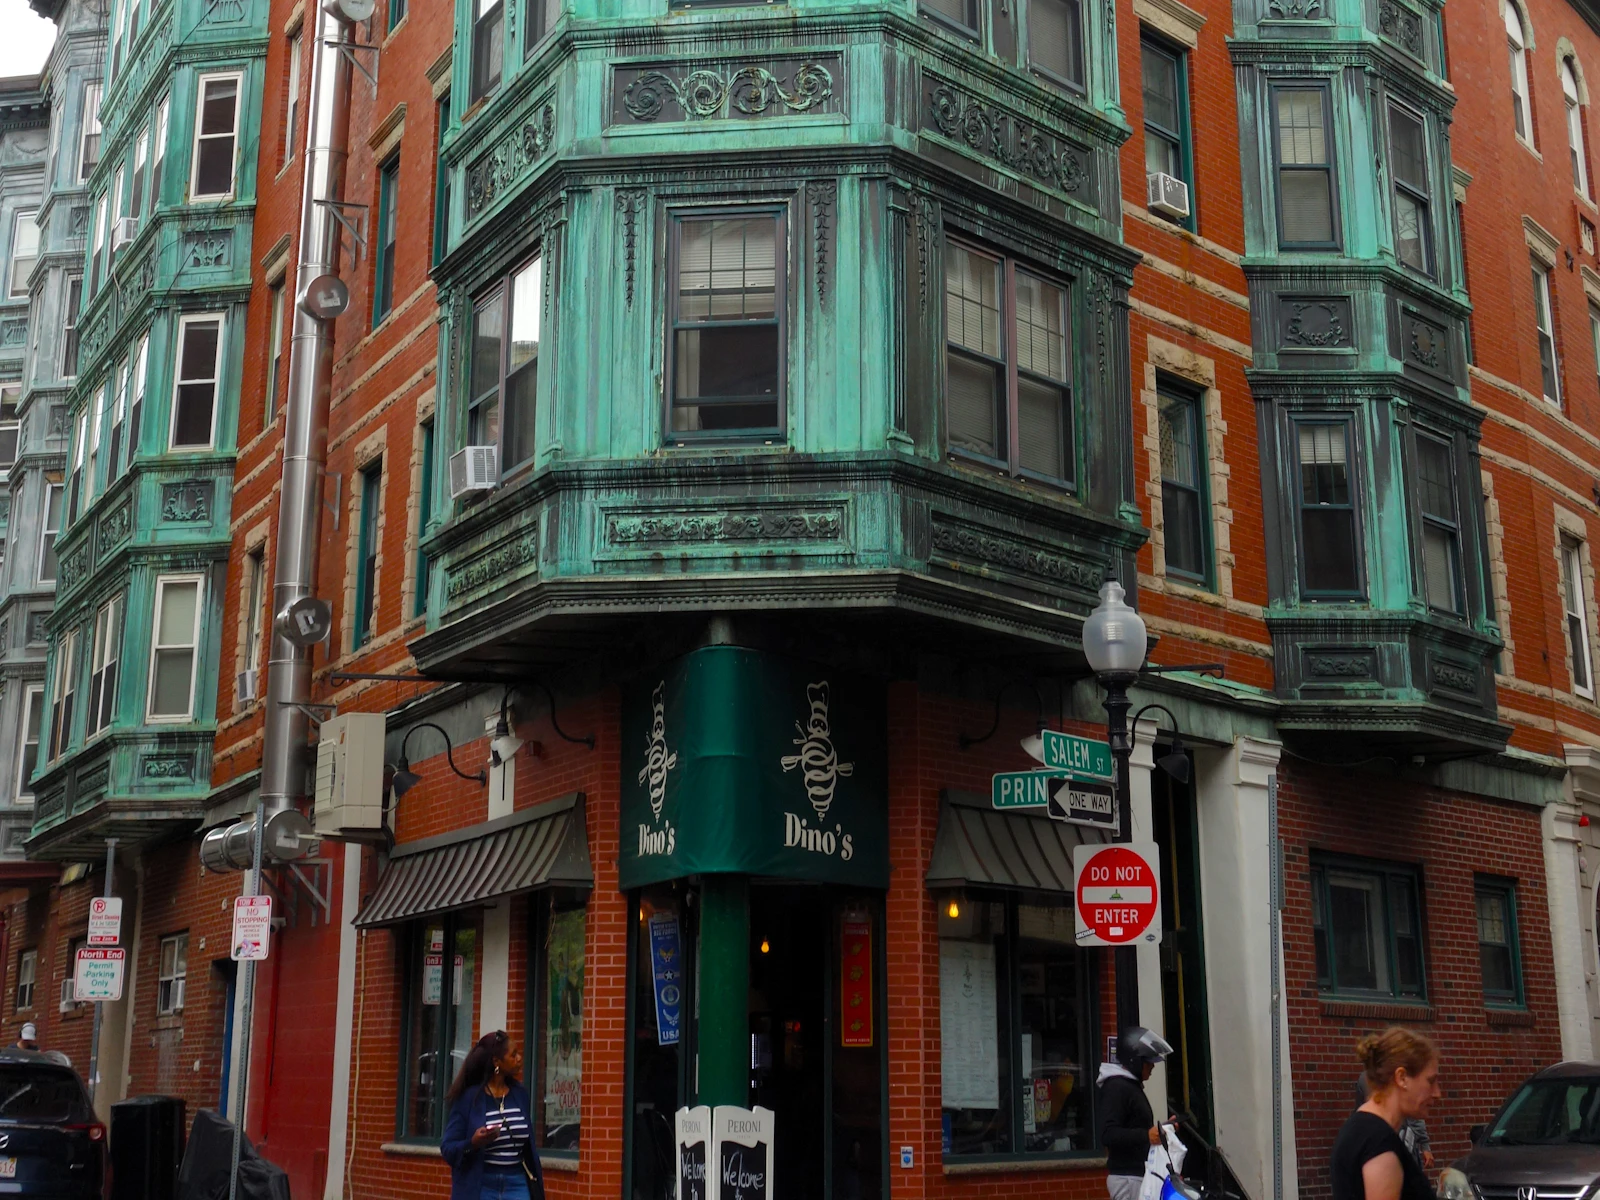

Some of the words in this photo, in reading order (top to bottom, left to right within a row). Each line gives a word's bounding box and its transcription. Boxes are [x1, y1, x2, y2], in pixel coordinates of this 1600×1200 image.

[1051, 736, 1090, 769] SALEM
[1096, 758, 1104, 772] ST
[1069, 792, 1087, 808] ONE
[1091, 794, 1109, 812] WAY
[637, 819, 675, 858] Dino's
[783, 812, 854, 861] Dino's
[1091, 867, 1110, 881] DO
[1116, 866, 1142, 881] NOT
[246, 908, 259, 916] NO
[1095, 909, 1139, 924] ENTER
[81, 950, 104, 959] North
[106, 950, 122, 959] End
[88, 961, 113, 969] Permit
[86, 970, 115, 979] Parking
[91, 979, 108, 988] Only
[681, 1119, 702, 1133] PERONI
[727, 1119, 761, 1133] PERONI
[723, 1150, 765, 1190] Welcome
